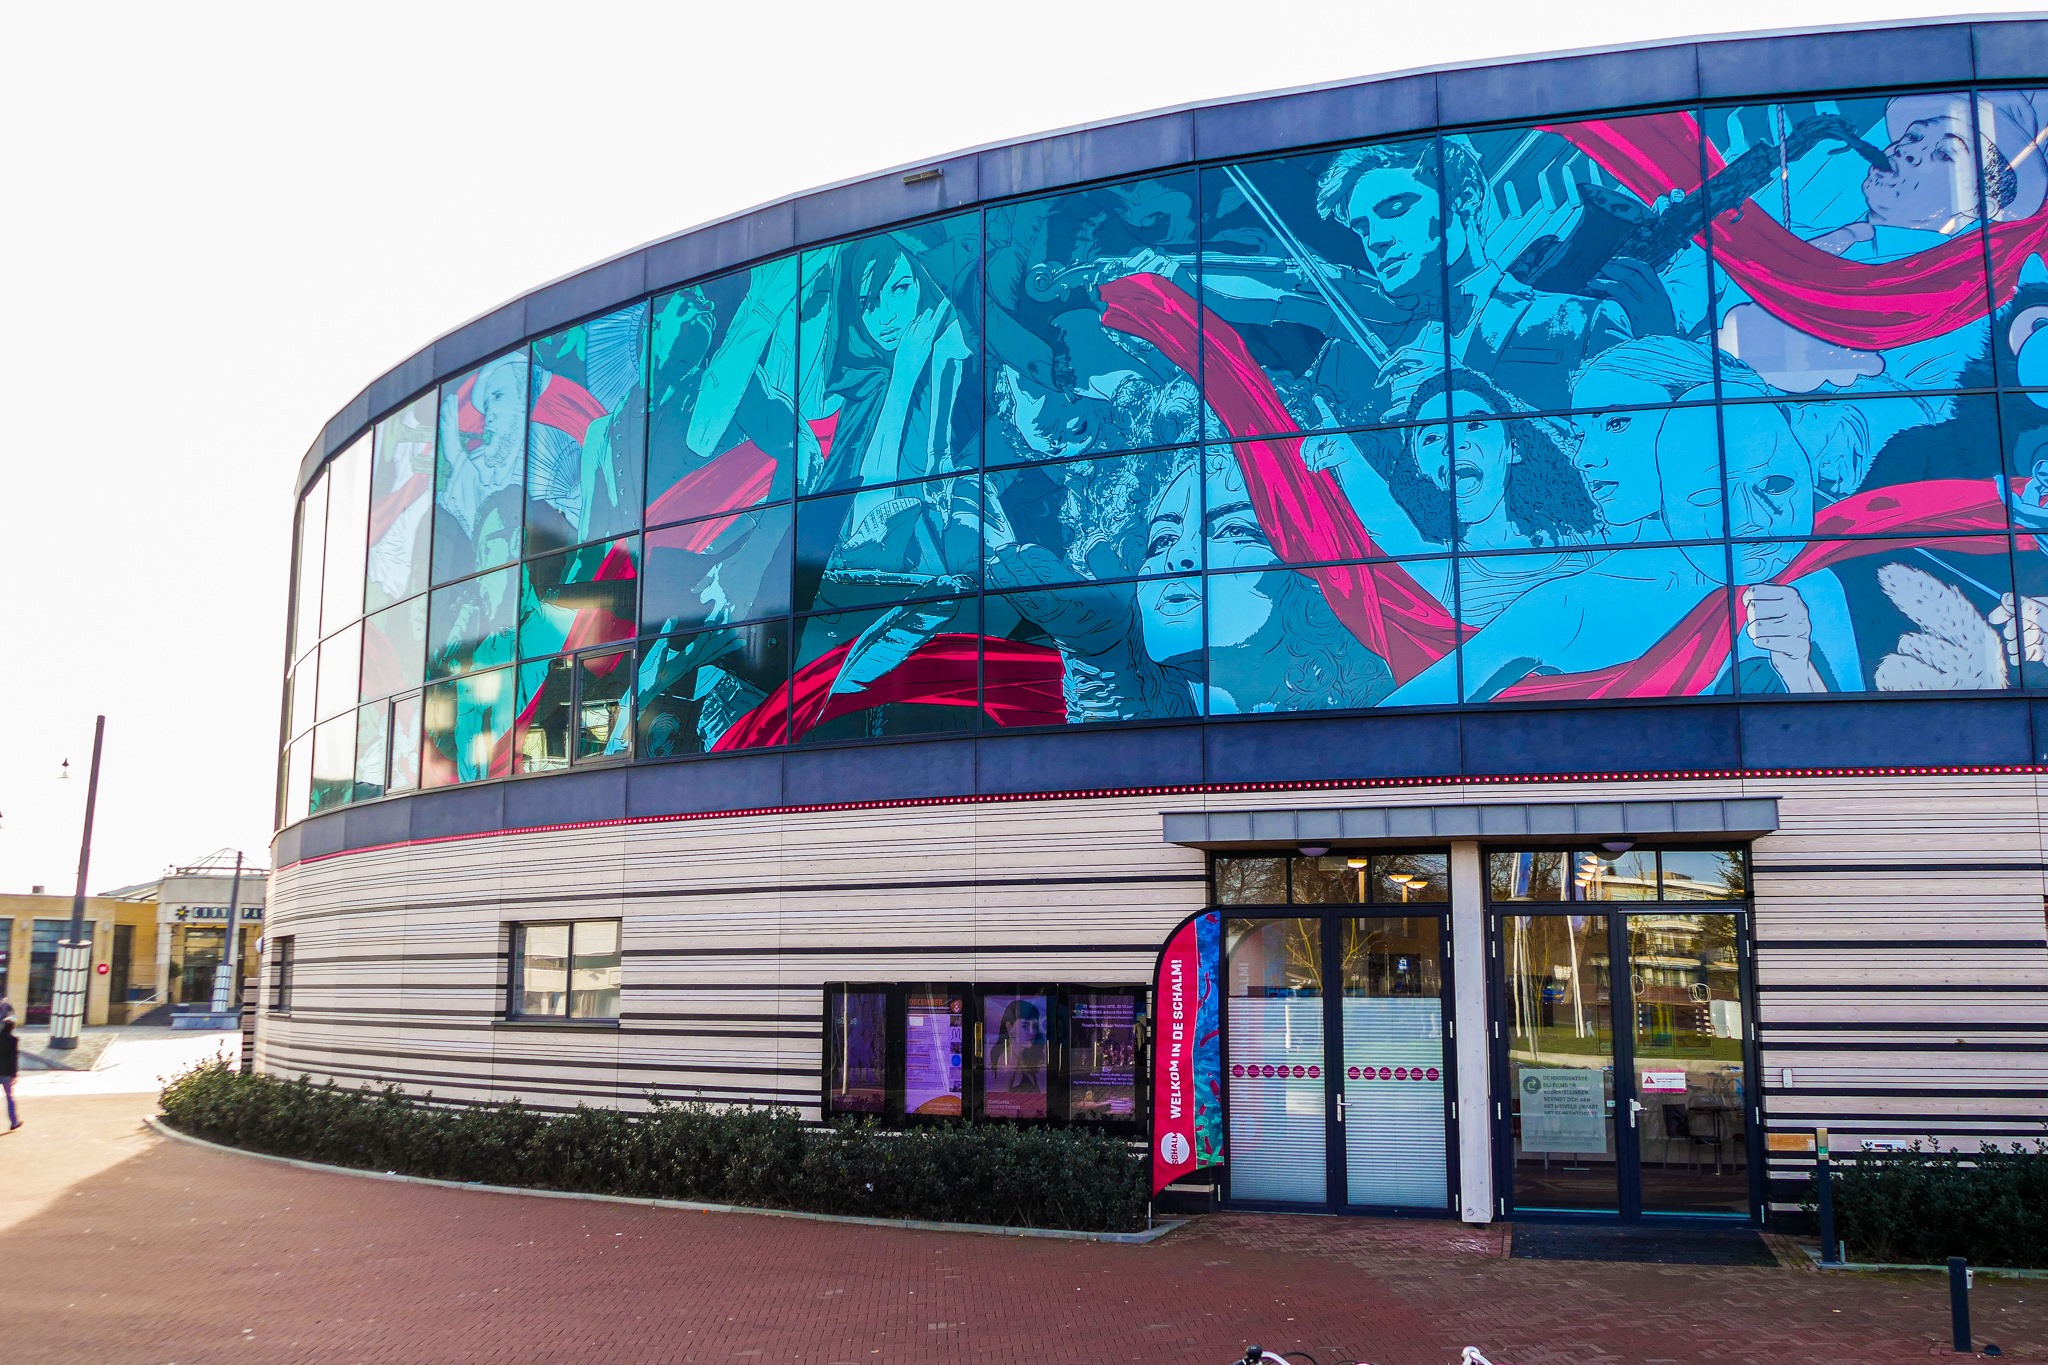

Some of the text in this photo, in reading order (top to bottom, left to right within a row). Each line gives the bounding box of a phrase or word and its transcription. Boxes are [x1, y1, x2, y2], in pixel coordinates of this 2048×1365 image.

[193, 907, 229, 918] CITY
[1169, 960, 1184, 1119] WELKOM IN DE SCHALM!
